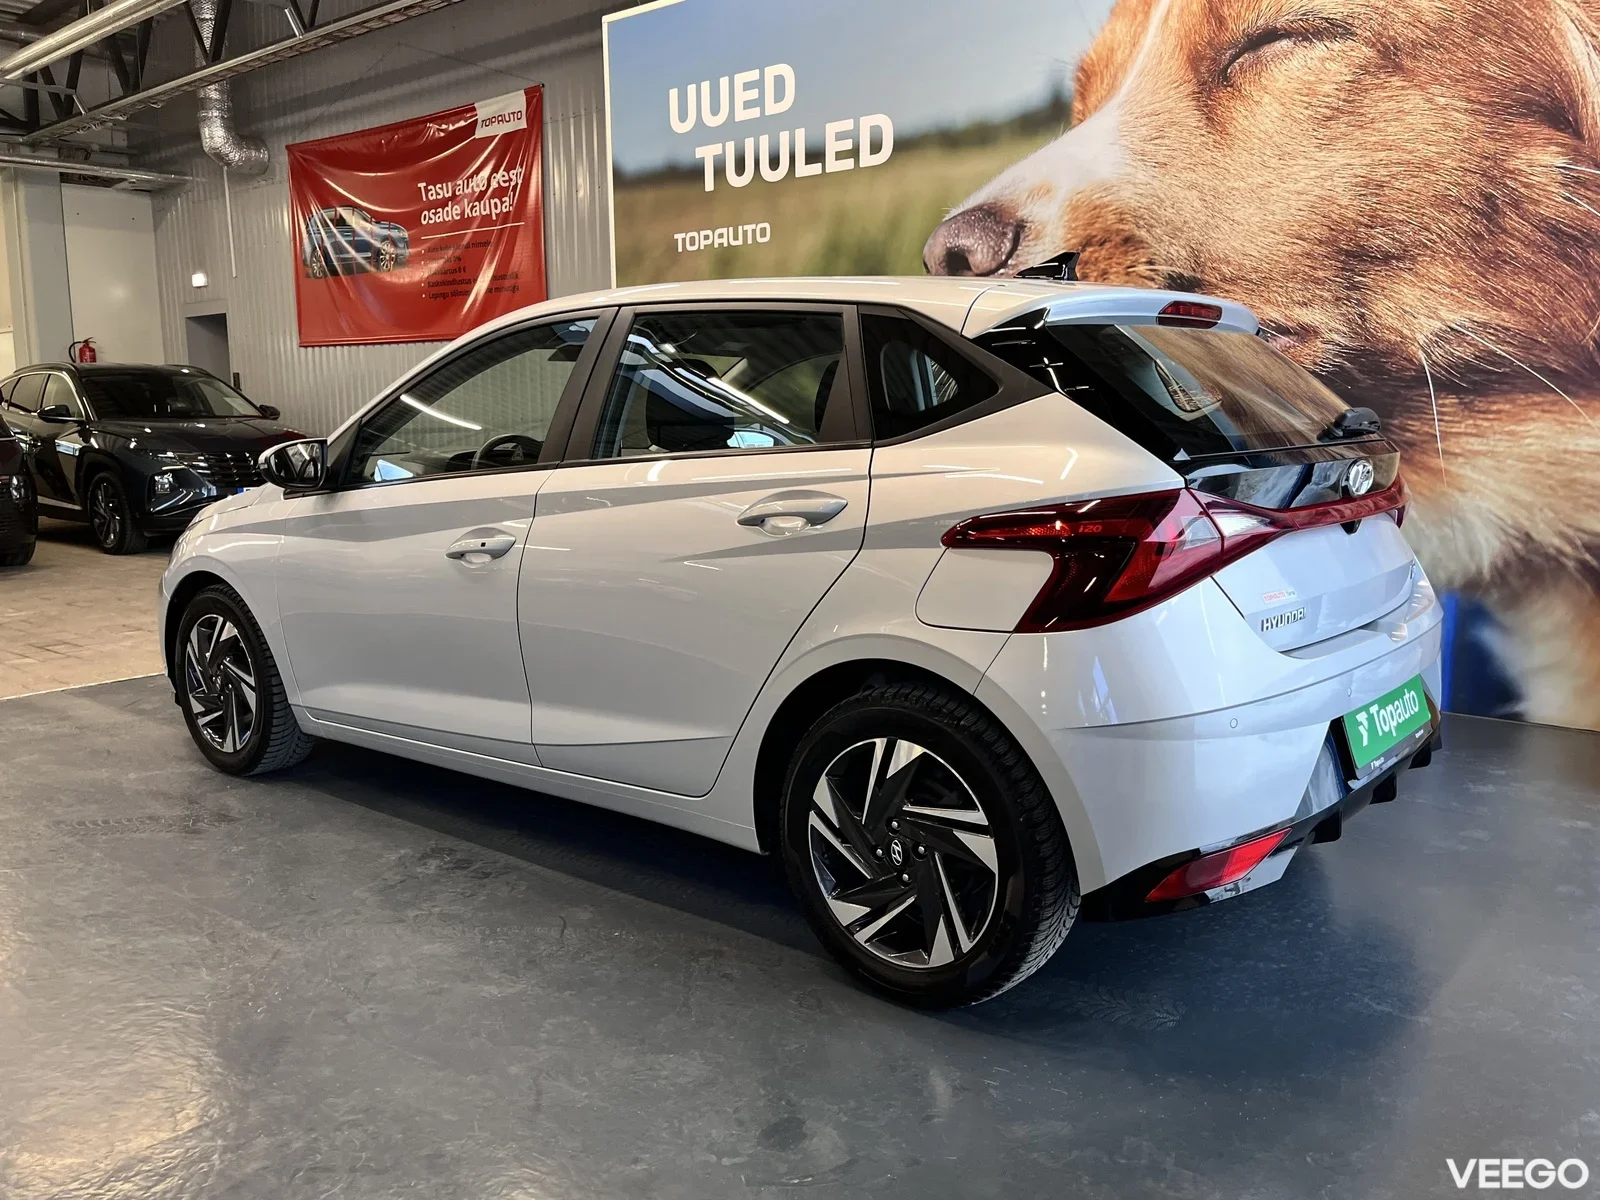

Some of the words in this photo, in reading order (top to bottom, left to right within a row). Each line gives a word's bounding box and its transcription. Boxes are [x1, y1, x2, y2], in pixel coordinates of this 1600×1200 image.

[668, 63, 796, 134] UUED
[480, 109, 523, 129] TOPAUTO
[695, 113, 894, 193] TUULED
[417, 181, 452, 201] Tasu
[455, 174, 488, 196] auto
[490, 166, 523, 189] eest
[420, 201, 461, 225] osade
[464, 191, 513, 220] kaupa!
[673, 222, 771, 252] TOPAUTO
[1260, 606, 1307, 633] HYUNDAI
[1369, 688, 1419, 737] Topauto
